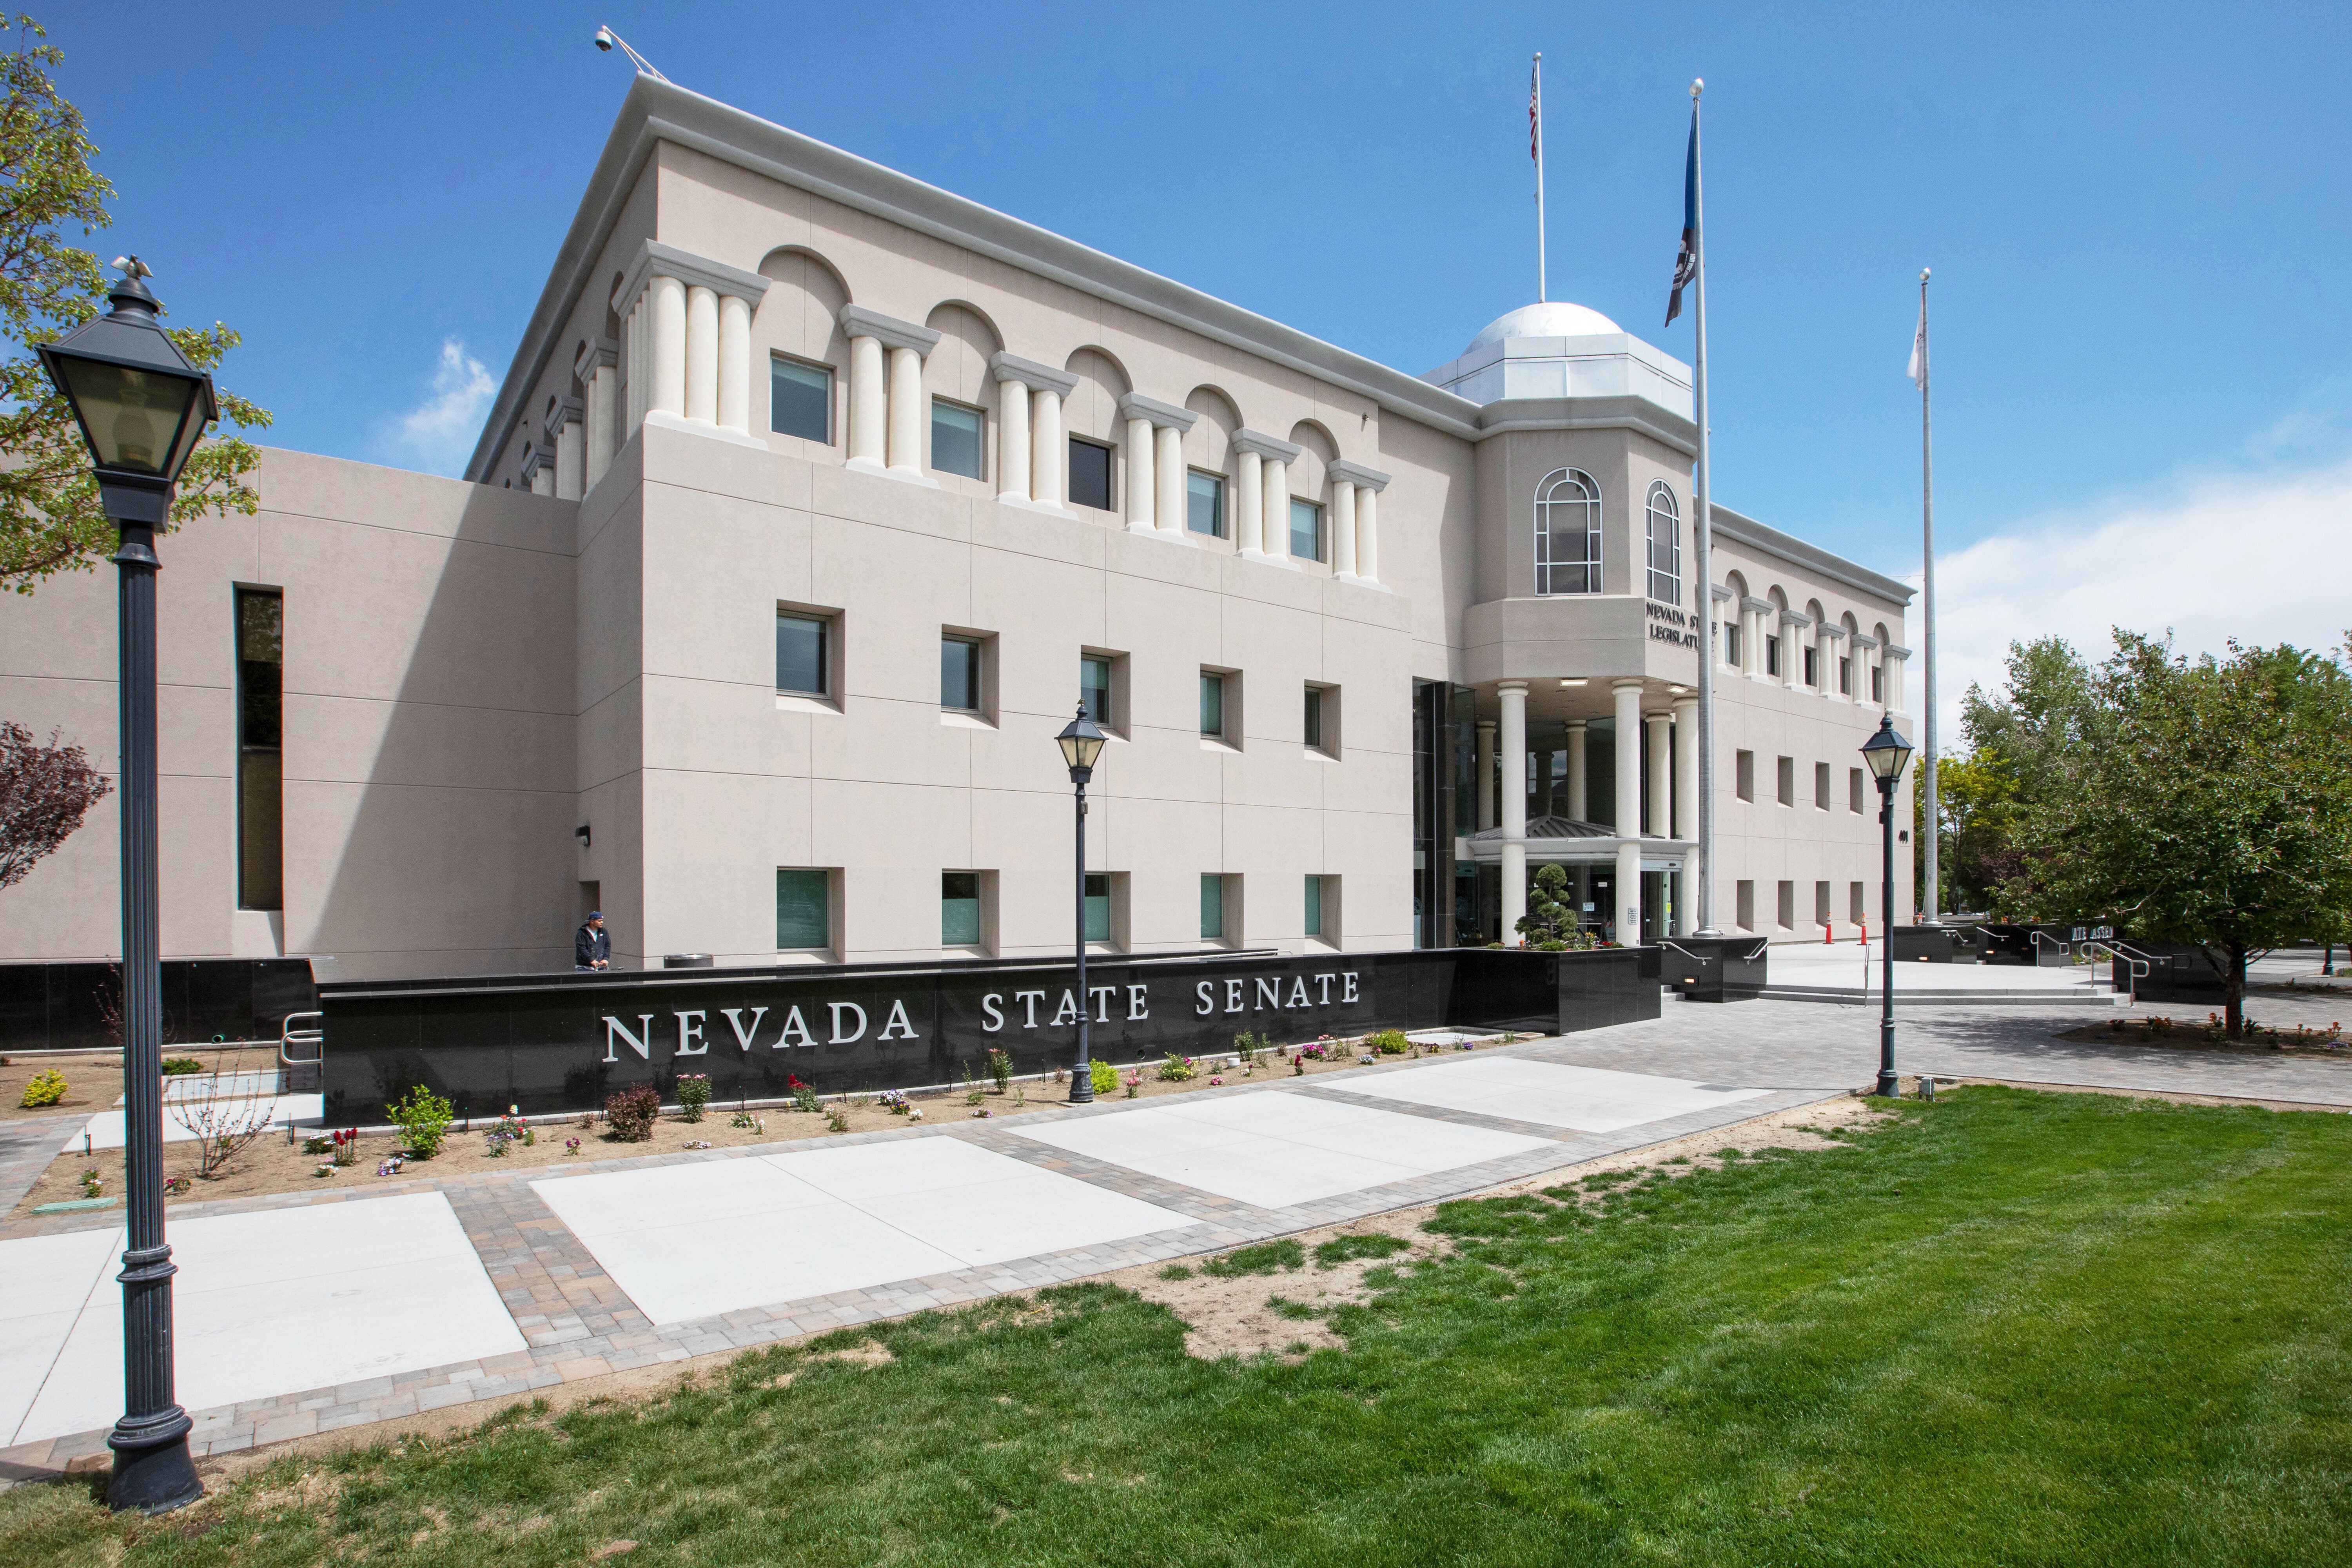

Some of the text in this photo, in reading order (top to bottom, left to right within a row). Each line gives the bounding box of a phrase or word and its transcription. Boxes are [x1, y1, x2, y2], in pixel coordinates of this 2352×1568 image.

[1646, 602, 1717, 634] NEVADA STE
[1898, 830, 1908, 842] 401
[602, 972, 1359, 1062] NEVADA STATE SENATE
